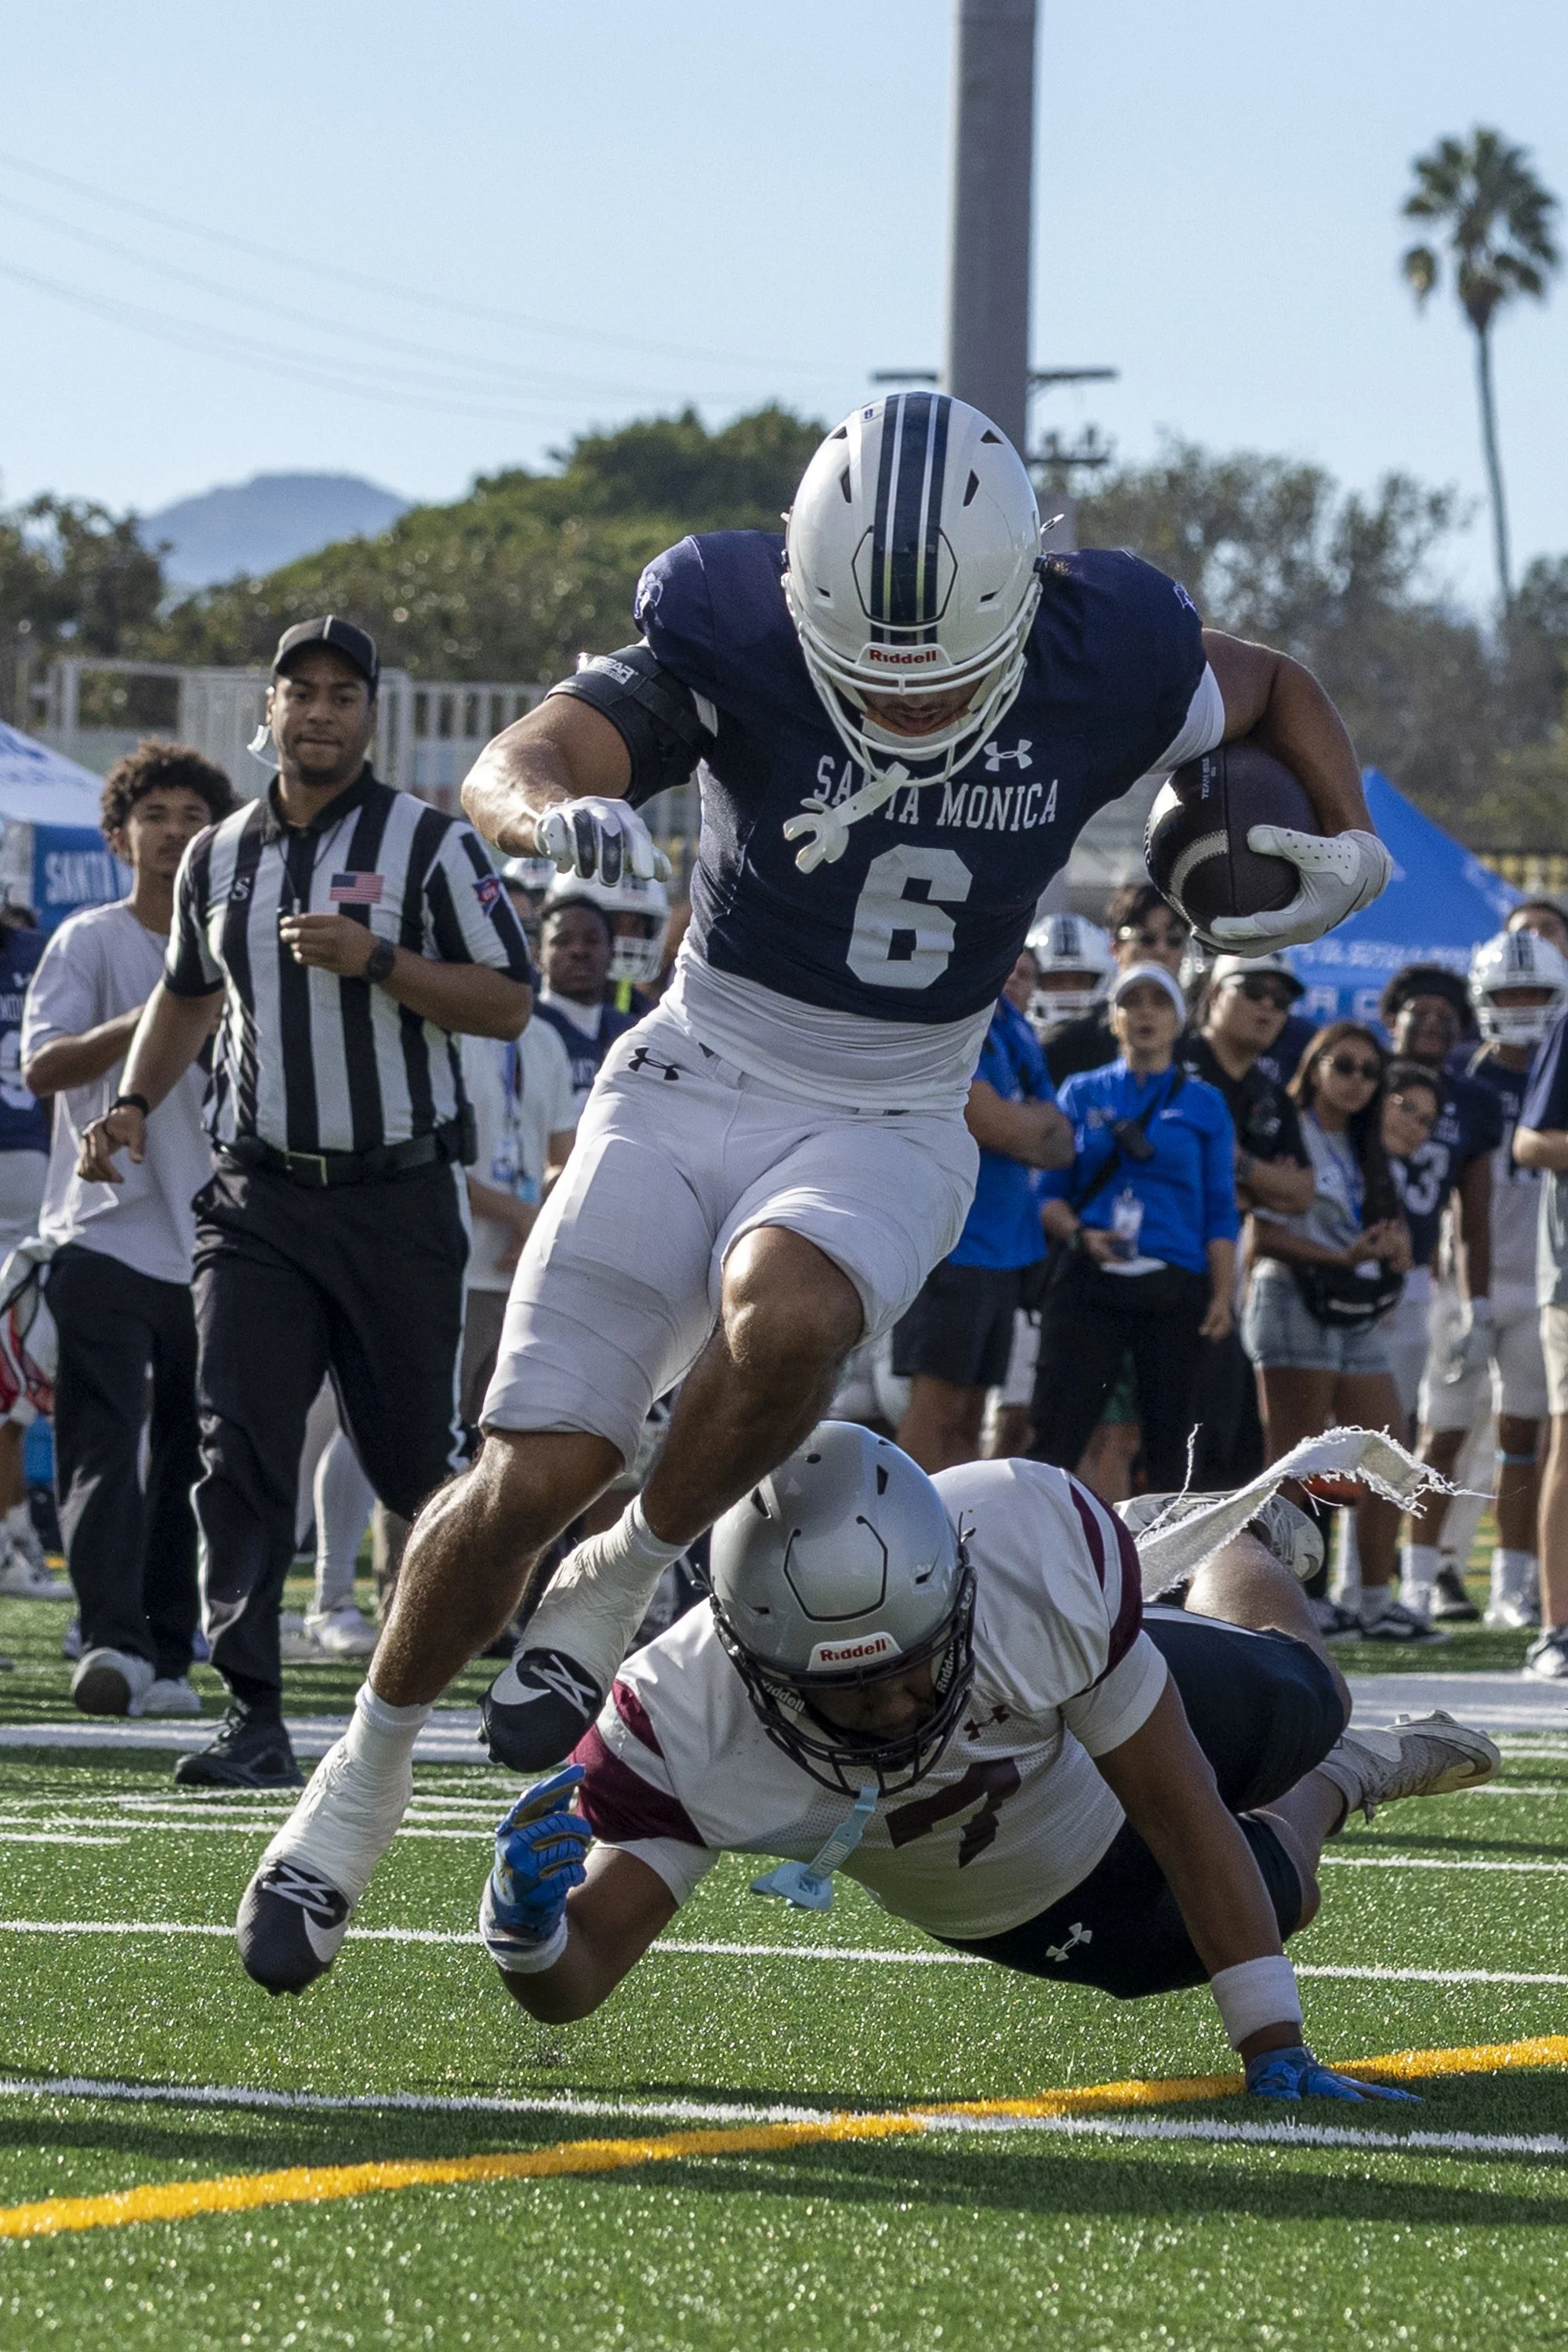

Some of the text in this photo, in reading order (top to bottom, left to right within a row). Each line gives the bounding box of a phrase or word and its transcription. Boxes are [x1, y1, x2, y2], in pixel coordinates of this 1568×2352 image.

[869, 649, 937, 663] Riddell
[937, 779, 1058, 832] MONICA
[230, 877, 250, 901] S
[846, 844, 973, 990] 6
[820, 1639, 887, 1661] Riddell
[885, 1757, 1022, 1869] 7
